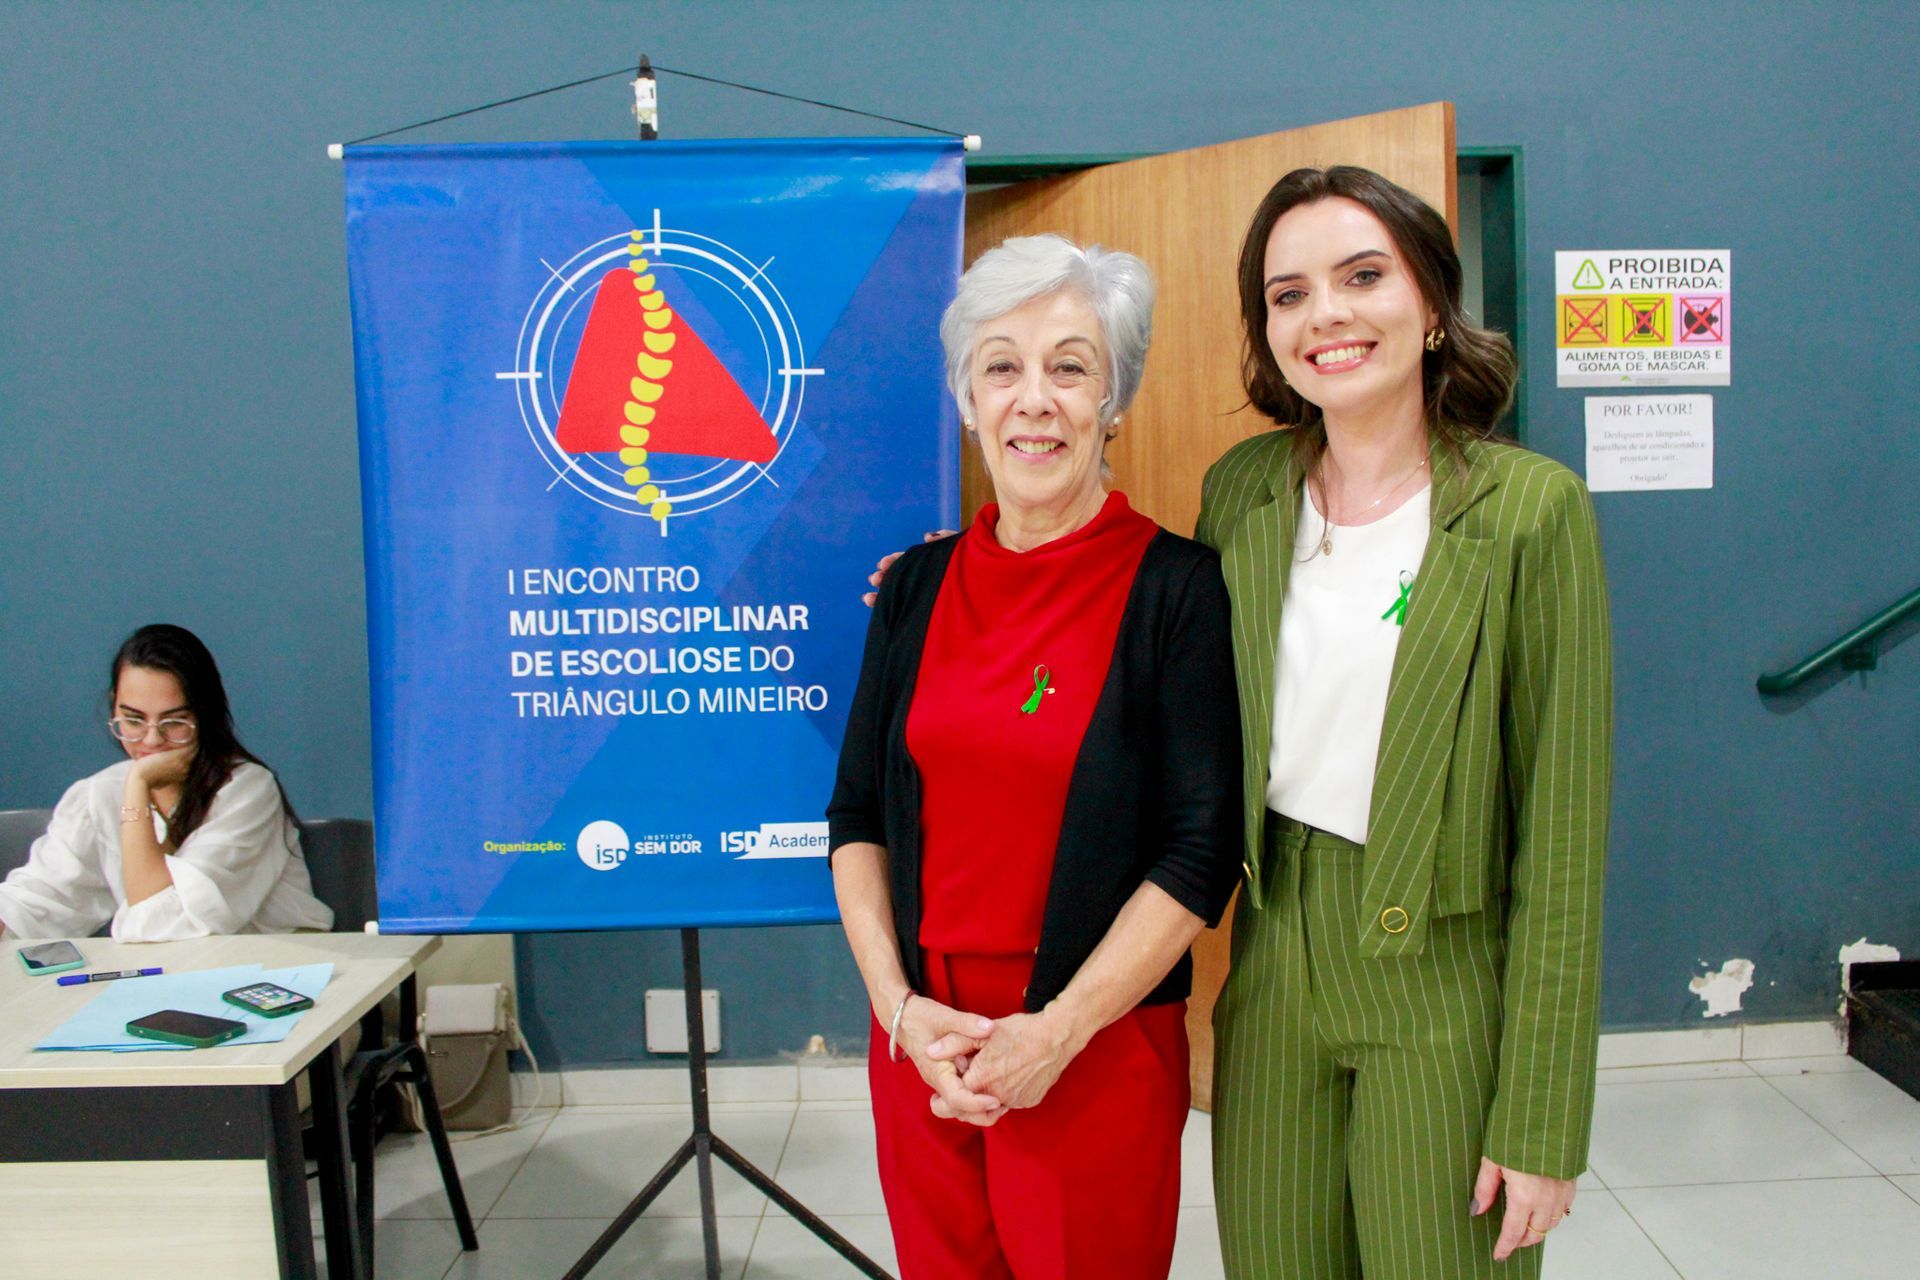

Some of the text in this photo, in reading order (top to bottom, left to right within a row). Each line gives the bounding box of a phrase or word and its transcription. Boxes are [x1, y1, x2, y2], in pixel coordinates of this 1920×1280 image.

[1609, 257, 1724, 274] PROIBIDA
[1610, 277, 1723, 290] A ENTRADA:
[1653, 350, 1711, 360] BEBIDAS
[1715, 350, 1723, 360] E
[1578, 362, 1621, 372] GOMA
[1626, 362, 1645, 372] DE
[1603, 403, 1693, 417] POR FAVOR!
[508, 565, 700, 596] I ENCONTRO
[509, 604, 810, 637] MULTIDISCIPLINAR
[511, 645, 796, 678] DE ESCOLIOSE DO
[511, 685, 829, 718] TRIÂNGULO MINEIRO
[643, 833, 694, 841] INSTITUTO
[720, 830, 760, 853] ISD
[483, 840, 567, 854] Organização:
[634, 840, 703, 855] SEM DOR
